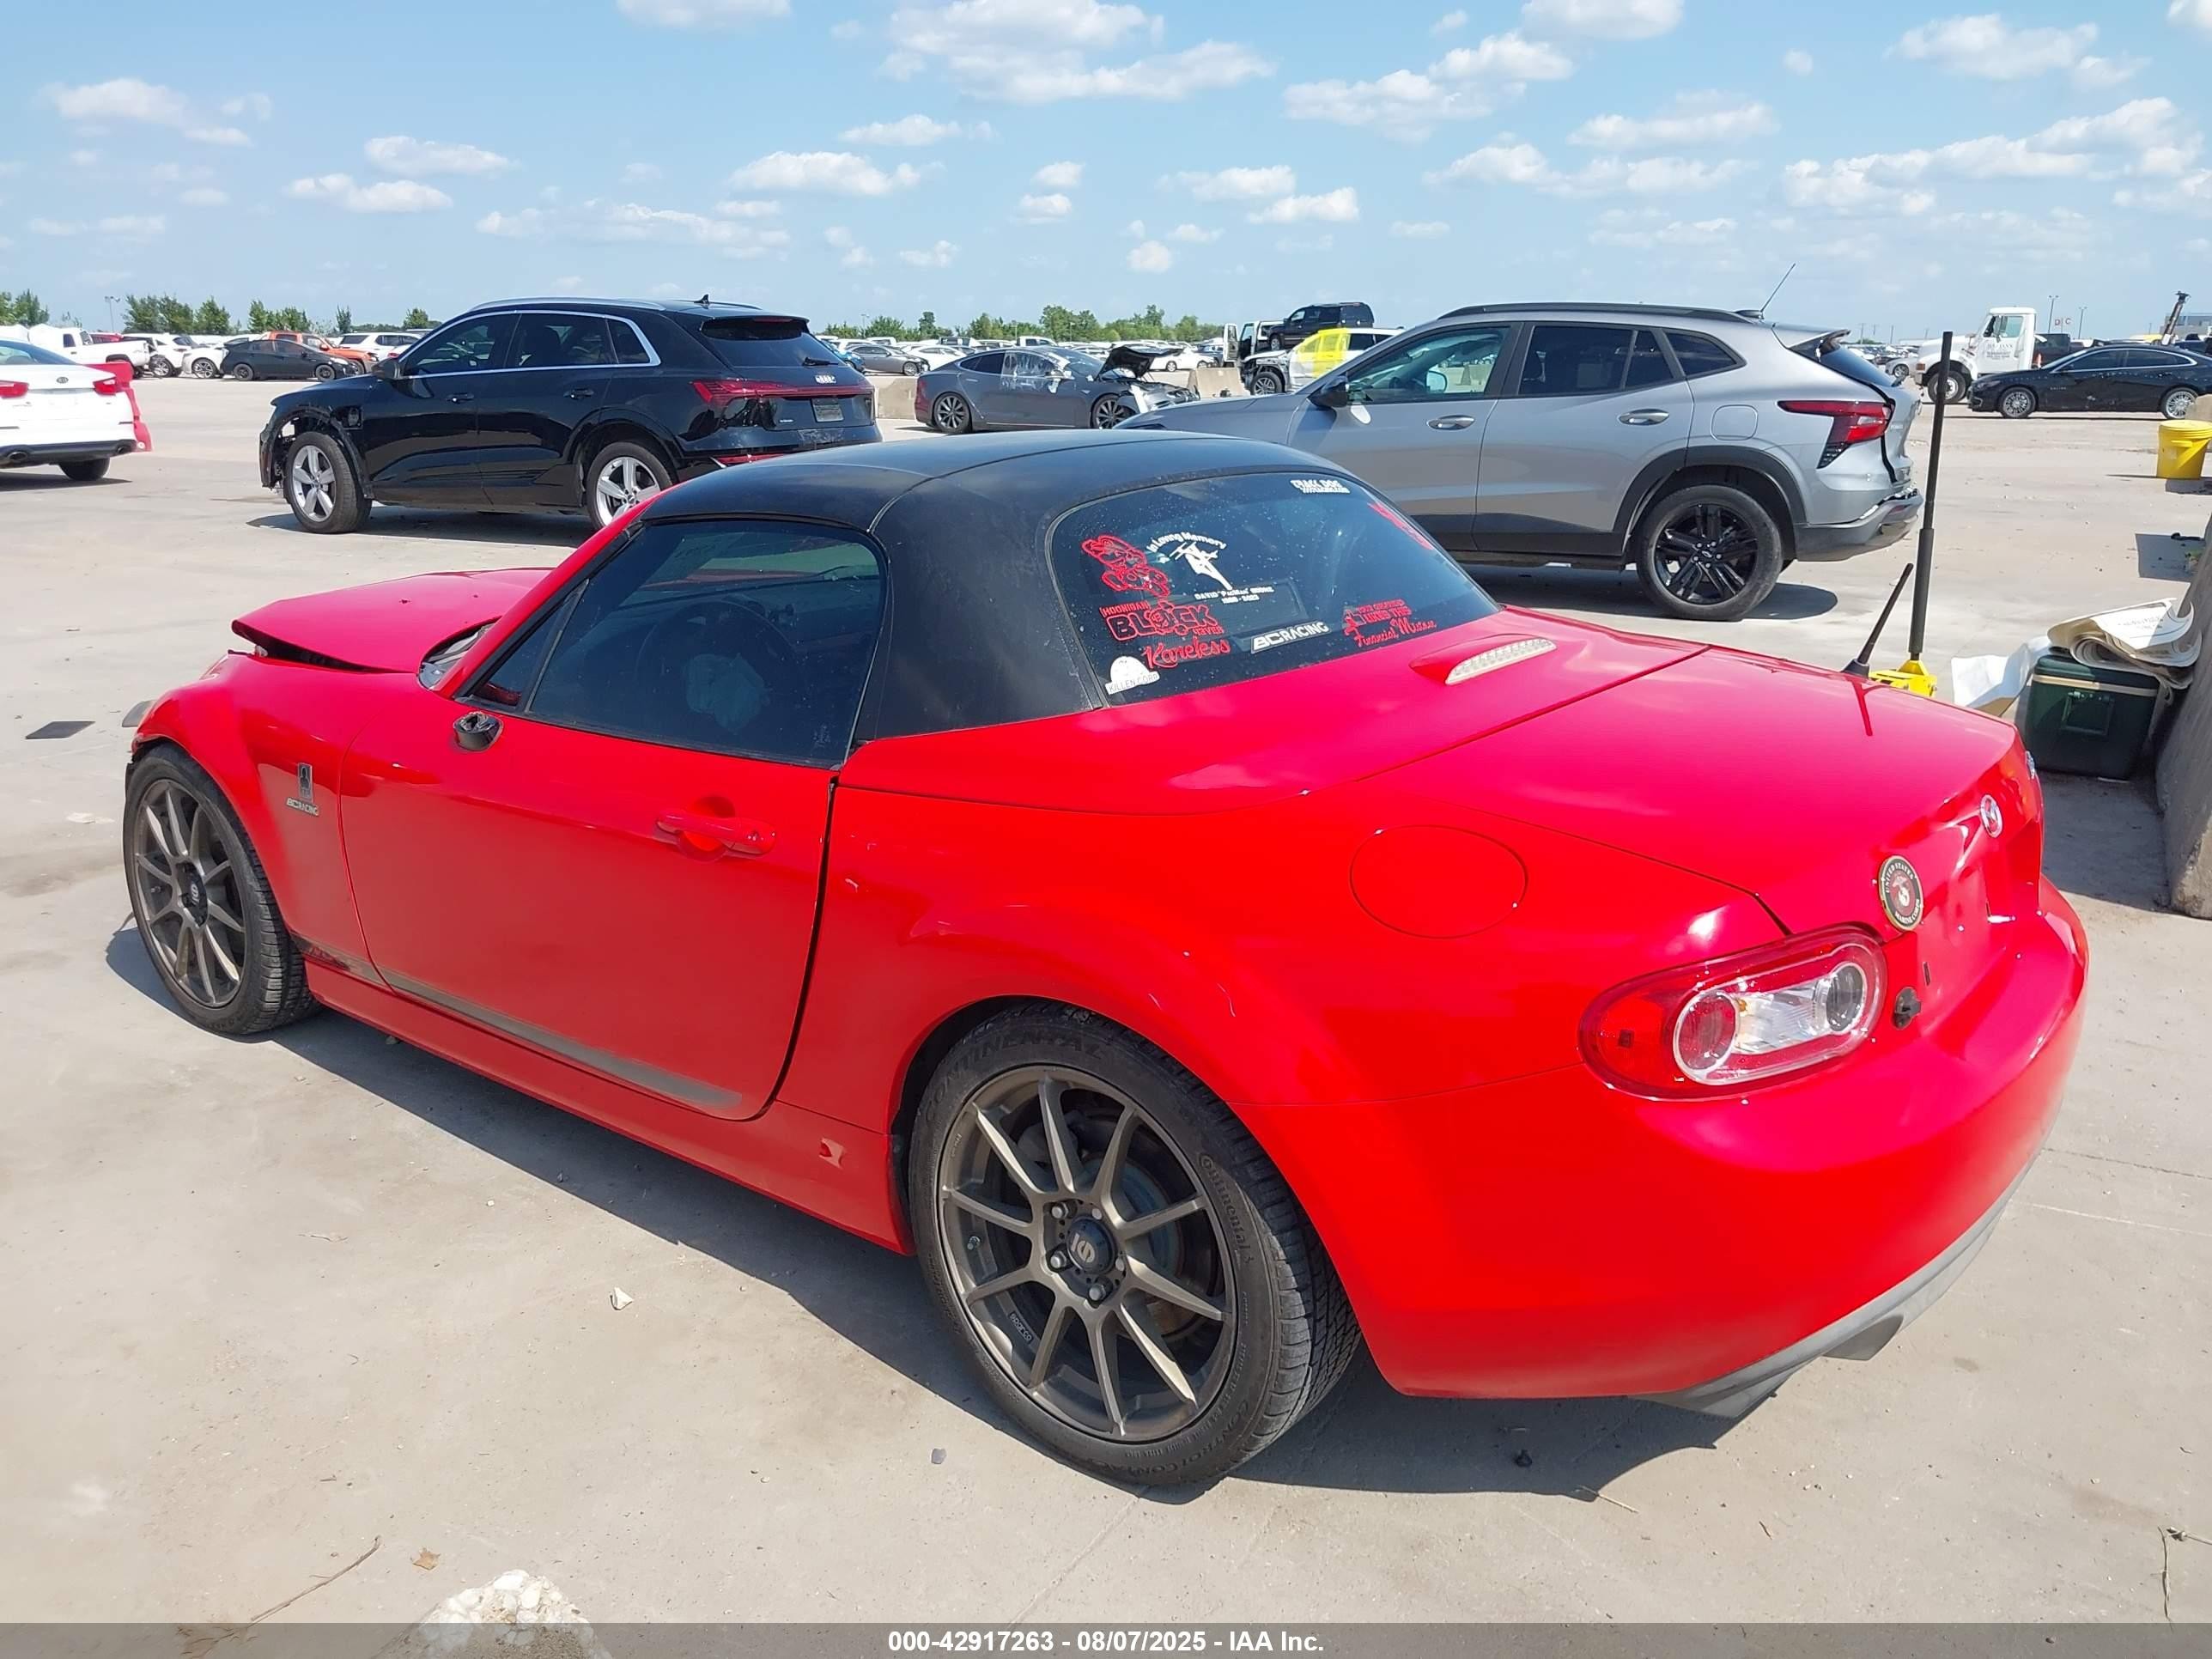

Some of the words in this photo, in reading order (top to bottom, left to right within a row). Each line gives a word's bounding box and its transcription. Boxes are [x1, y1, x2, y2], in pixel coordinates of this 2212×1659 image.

[1152, 532, 1184, 550] Loving
[1181, 532, 1228, 550] Memory
[1194, 591, 1218, 600] DAVID
[1107, 605, 1218, 641] BLOCK
[1109, 679, 1136, 692] KILLEN
[1137, 673, 1158, 684] CORP
[1886, 864, 1896, 893] UNITED
[1895, 862, 1914, 880] STATES
[1894, 910, 1914, 924] MARINE
